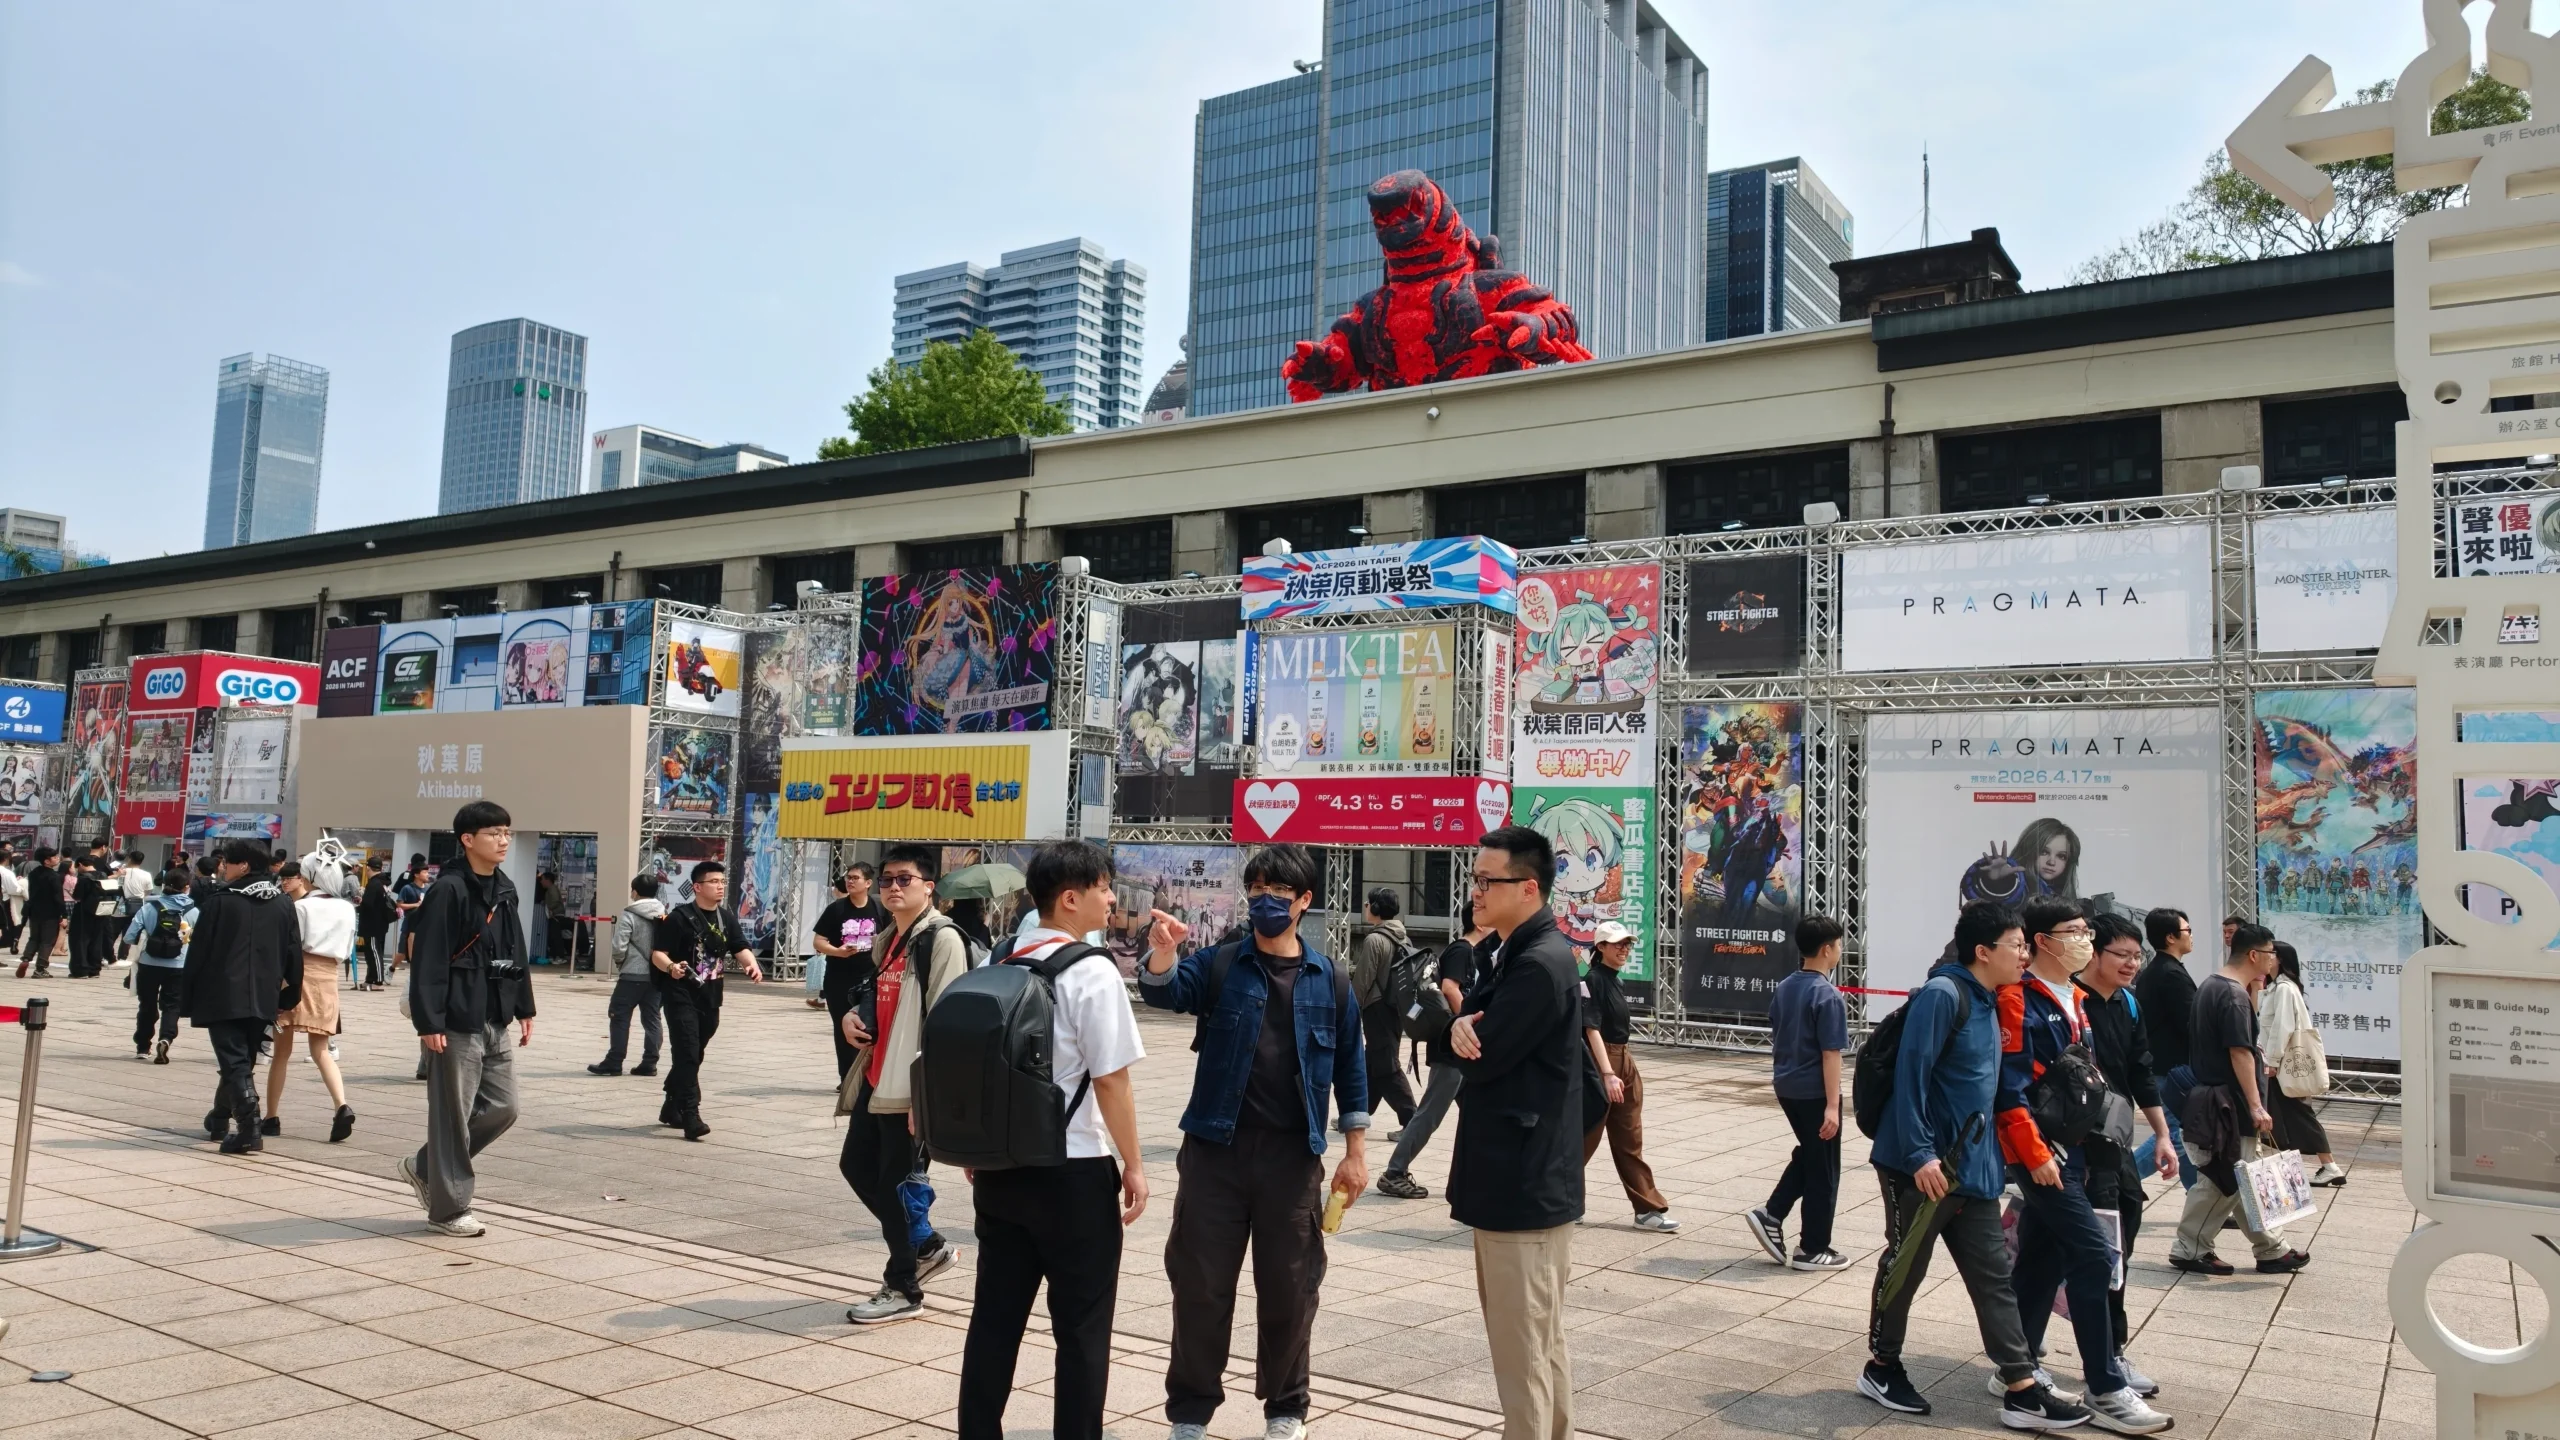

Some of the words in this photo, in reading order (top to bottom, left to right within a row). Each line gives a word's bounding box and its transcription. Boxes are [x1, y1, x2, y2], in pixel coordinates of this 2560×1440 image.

[2519, 123, 2560, 139] Event
[2511, 354, 2544, 368] 旅館
[2499, 417, 2548, 435] 辦公室
[594, 434, 608, 449] W
[2461, 504, 2533, 534] 聲優
[2463, 533, 2534, 565] 來啦
[1315, 560, 1356, 570] ACF2026
[1371, 556, 1401, 565] TAIPEI
[1284, 563, 1434, 601] 秋葉原動漫祭
[2275, 572, 2335, 584] MONSTER
[2337, 569, 2391, 581] HUNTER
[2303, 581, 2352, 592] STORIES
[1903, 586, 2139, 616] PRAGMATA
[1707, 609, 1740, 621] STREET
[1741, 607, 1779, 620] FIGHTER
[1271, 634, 1364, 681] MILK
[1370, 630, 1448, 676] TEA
[2454, 656, 2504, 669] 表演廳
[327, 657, 368, 679] ACF
[1250, 642, 1258, 704] ACF2026
[147, 672, 184, 695] GiGO
[221, 674, 297, 702] GiGO
[347, 681, 365, 689] TAIPEI
[1245, 672, 1251, 686] IN
[992, 686, 1040, 708] 每天在刷新
[1523, 712, 1647, 735] 秋葉原同人祭
[1271, 738, 1298, 748] 伯朗奶茶
[1931, 737, 2154, 756] PRAGMATA
[417, 743, 484, 775] 秋葉原
[1321, 763, 1354, 773] 新裝亮相
[1537, 748, 1631, 778] 舉辦中!
[417, 780, 483, 799] Akihabara
[976, 780, 1022, 802] 台北市
[1247, 799, 1297, 809] 秋葉原動漫祭
[1330, 795, 1363, 811] 4.3
[1391, 795, 1404, 811] 5
[1368, 802, 1384, 811] to
[1480, 799, 1505, 809] ACF2026
[1487, 807, 1505, 817] TAIPEI
[1620, 797, 1646, 976] 蜜瓜書店台北店
[2501, 897, 2522, 916] P
[1695, 927, 1731, 940] STREET
[1732, 929, 1770, 942] FIGHTER
[1701, 974, 1779, 993] 好評發售中
[2308, 972, 2363, 984] STORIES
[2494, 1002, 2524, 1012] Guide
[2527, 1004, 2550, 1016] Map
[2312, 1012, 2391, 1033] 評發售中
